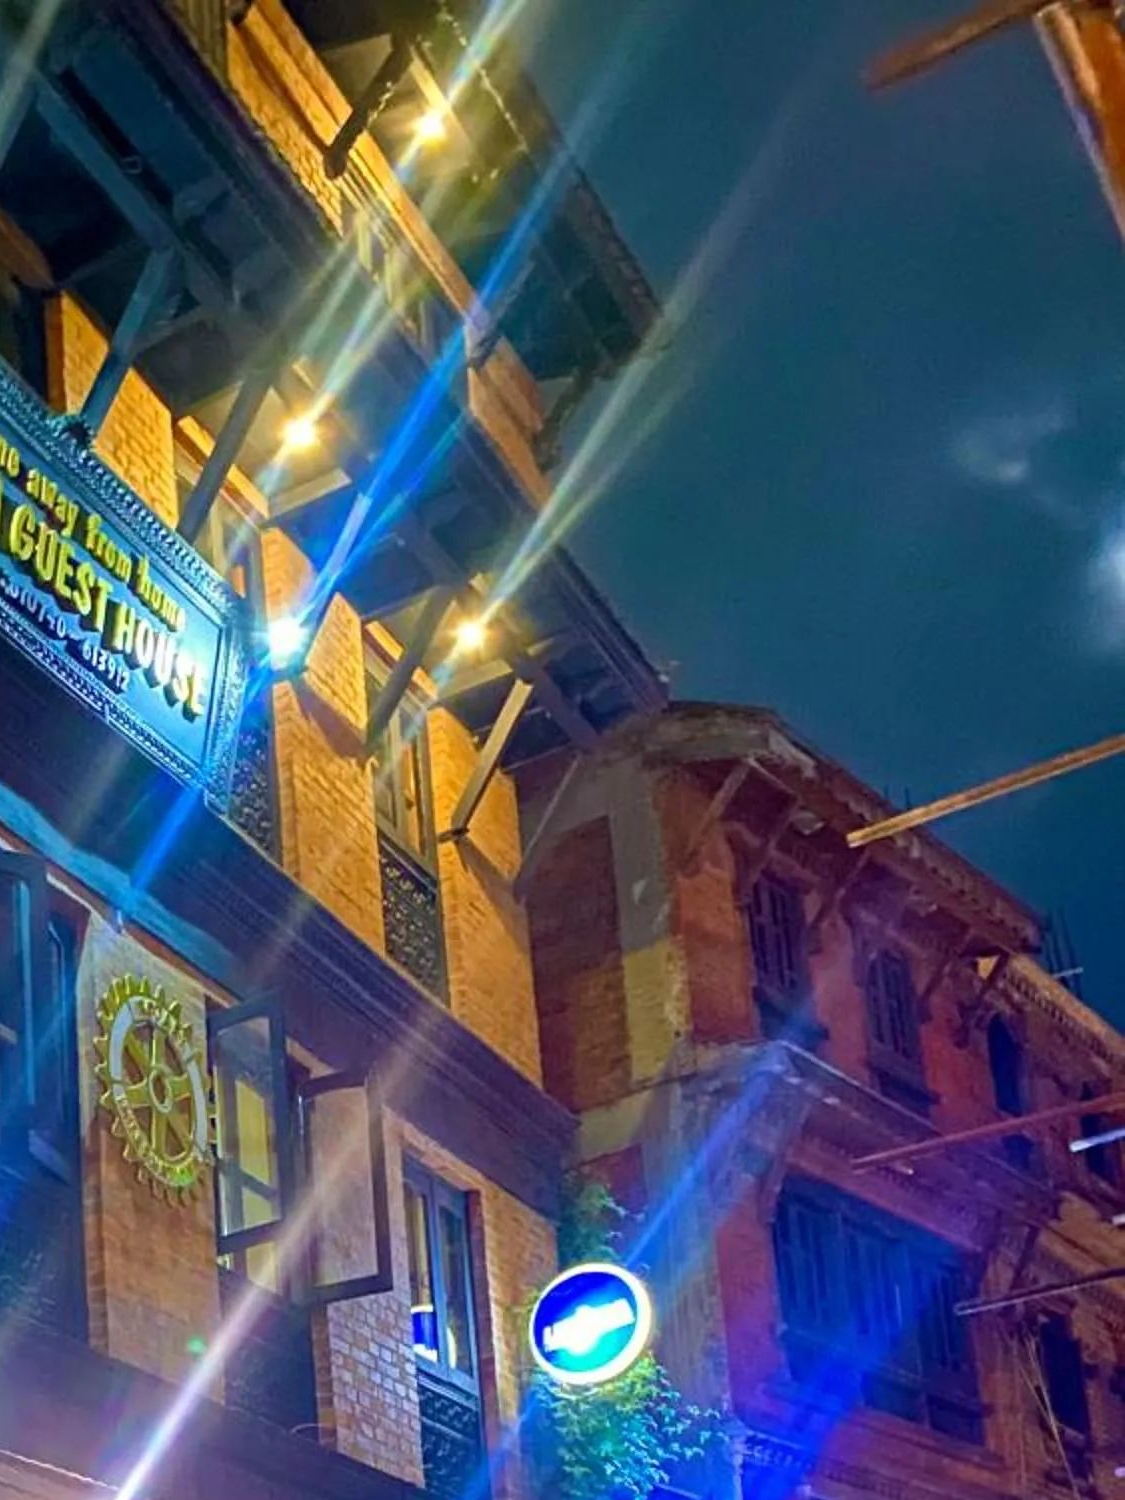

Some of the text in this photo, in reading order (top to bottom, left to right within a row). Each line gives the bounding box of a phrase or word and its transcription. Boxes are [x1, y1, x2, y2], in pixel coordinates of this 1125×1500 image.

[10, 503, 114, 632] GUEST
[115, 606, 204, 717] HOUSE
[26, 468, 79, 537] away
[86, 513, 132, 582] from
[137, 553, 186, 633] home
